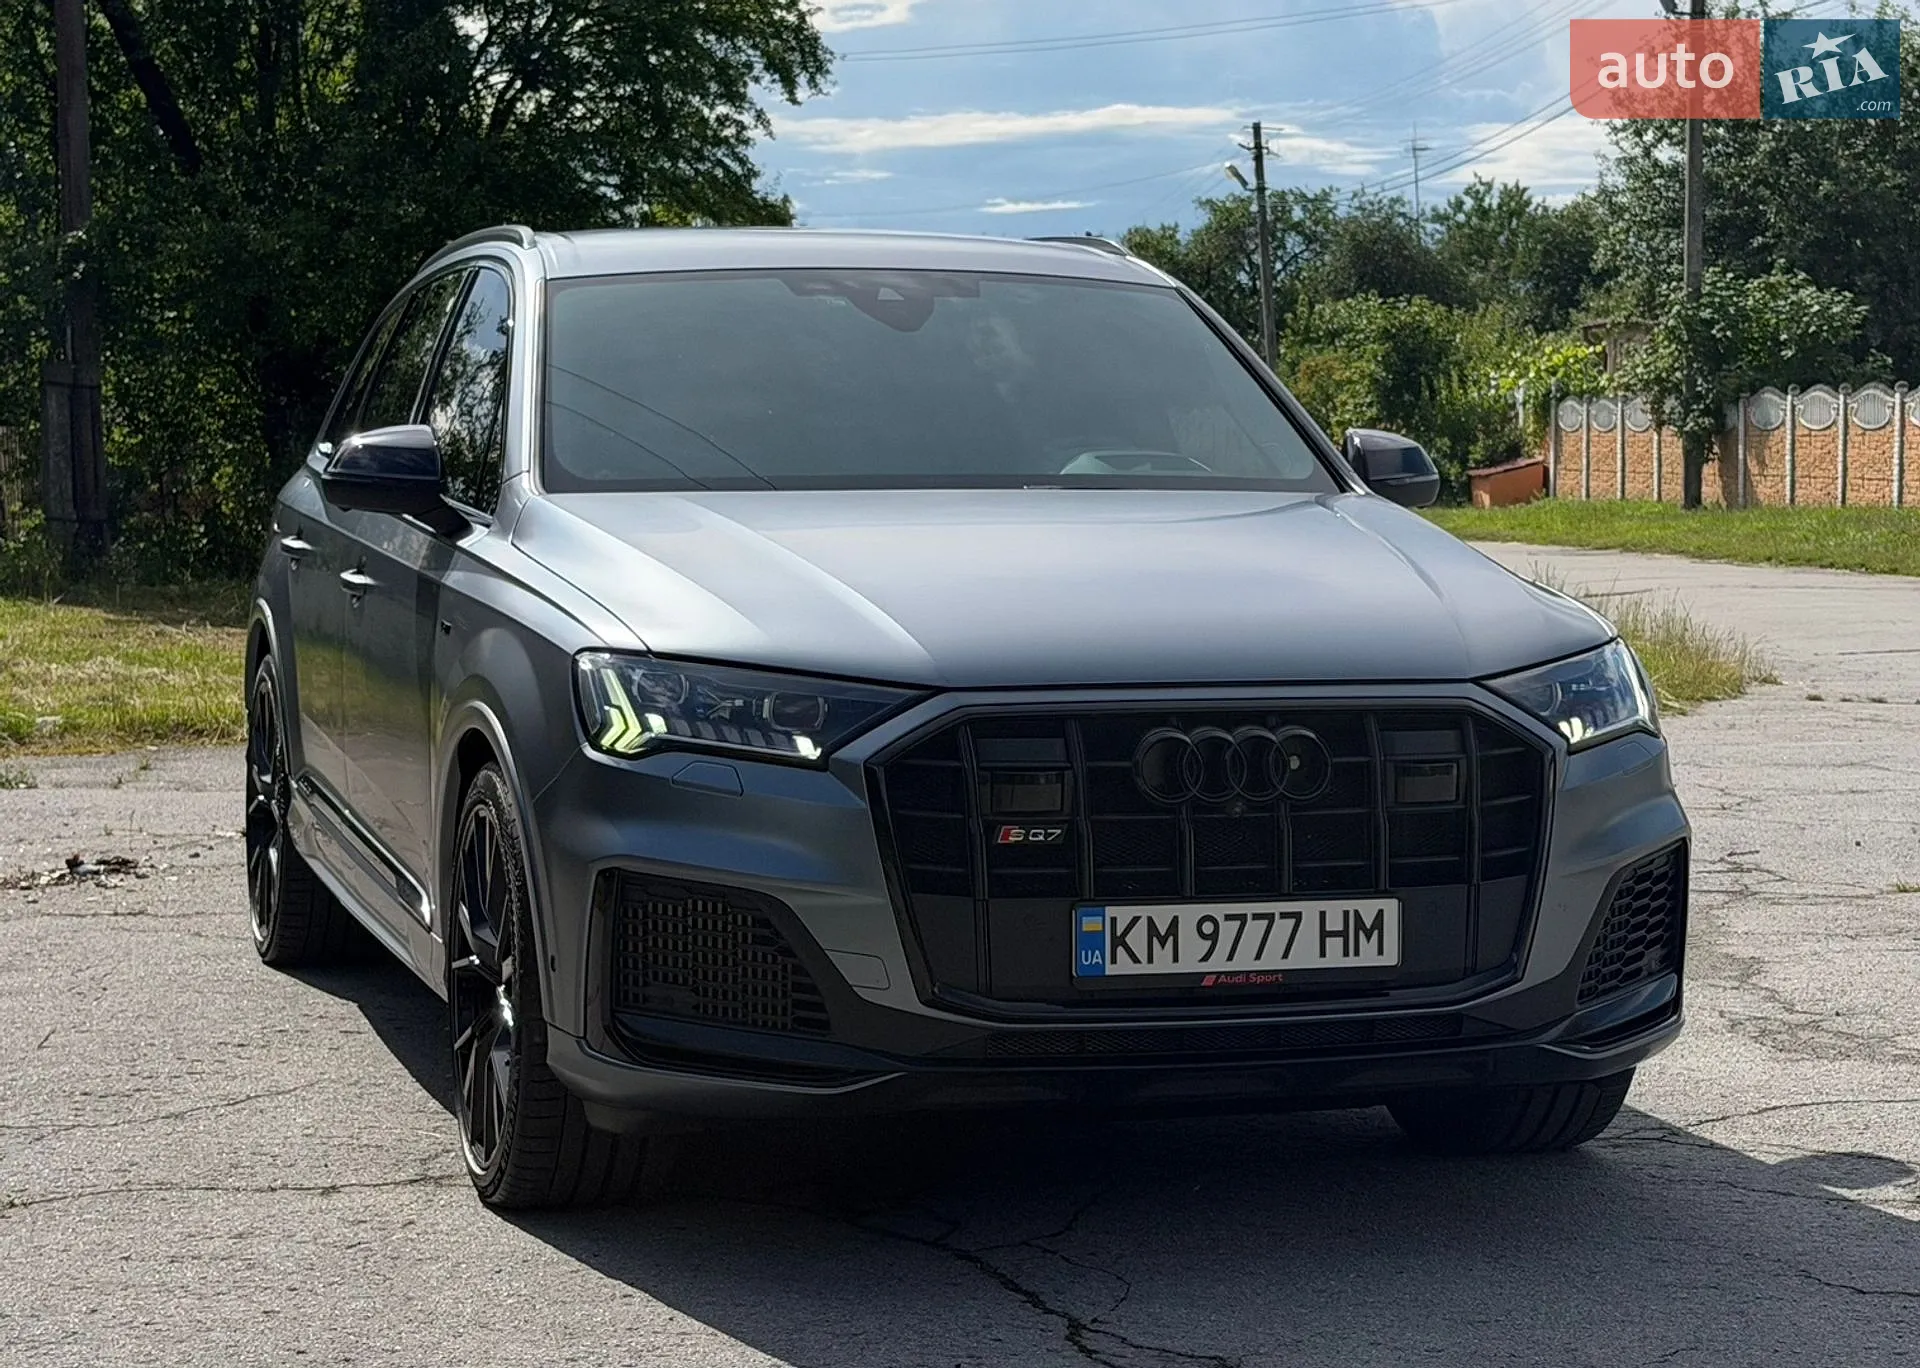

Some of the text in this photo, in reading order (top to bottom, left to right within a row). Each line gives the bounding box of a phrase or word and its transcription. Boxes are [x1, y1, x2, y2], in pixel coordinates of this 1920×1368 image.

[1109, 908, 1385, 965] KM 9777 HM
[1081, 950, 1103, 966] UA
[1219, 973, 1283, 984] Audi Sport
